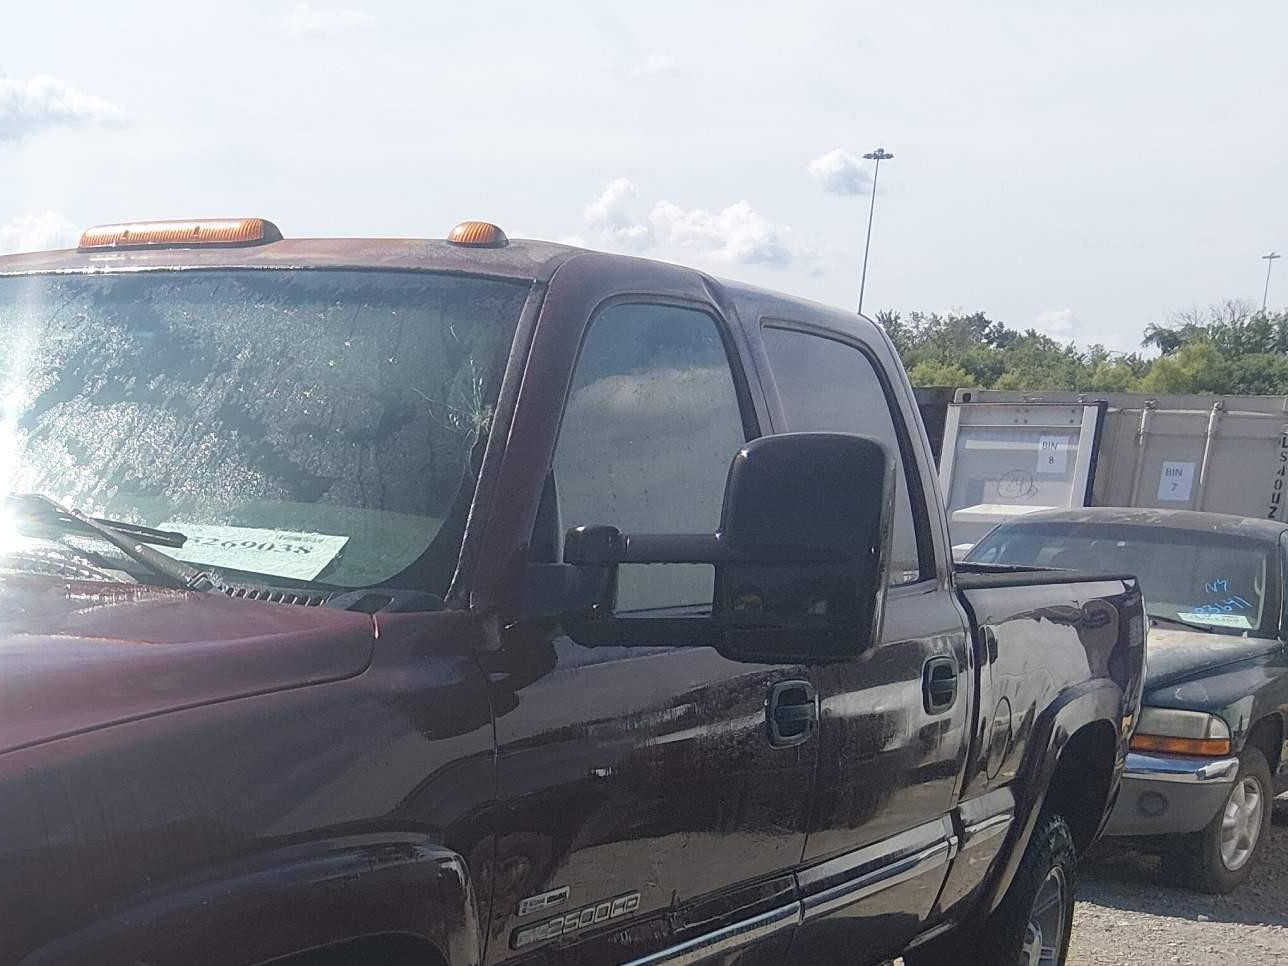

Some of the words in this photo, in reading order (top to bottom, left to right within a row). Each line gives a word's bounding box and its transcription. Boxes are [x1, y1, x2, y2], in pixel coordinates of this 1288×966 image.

[1042, 441, 1058, 450] BIN
[1048, 455, 1055, 465] 8
[1165, 467, 1183, 477] BIN
[1171, 482, 1178, 492] 7
